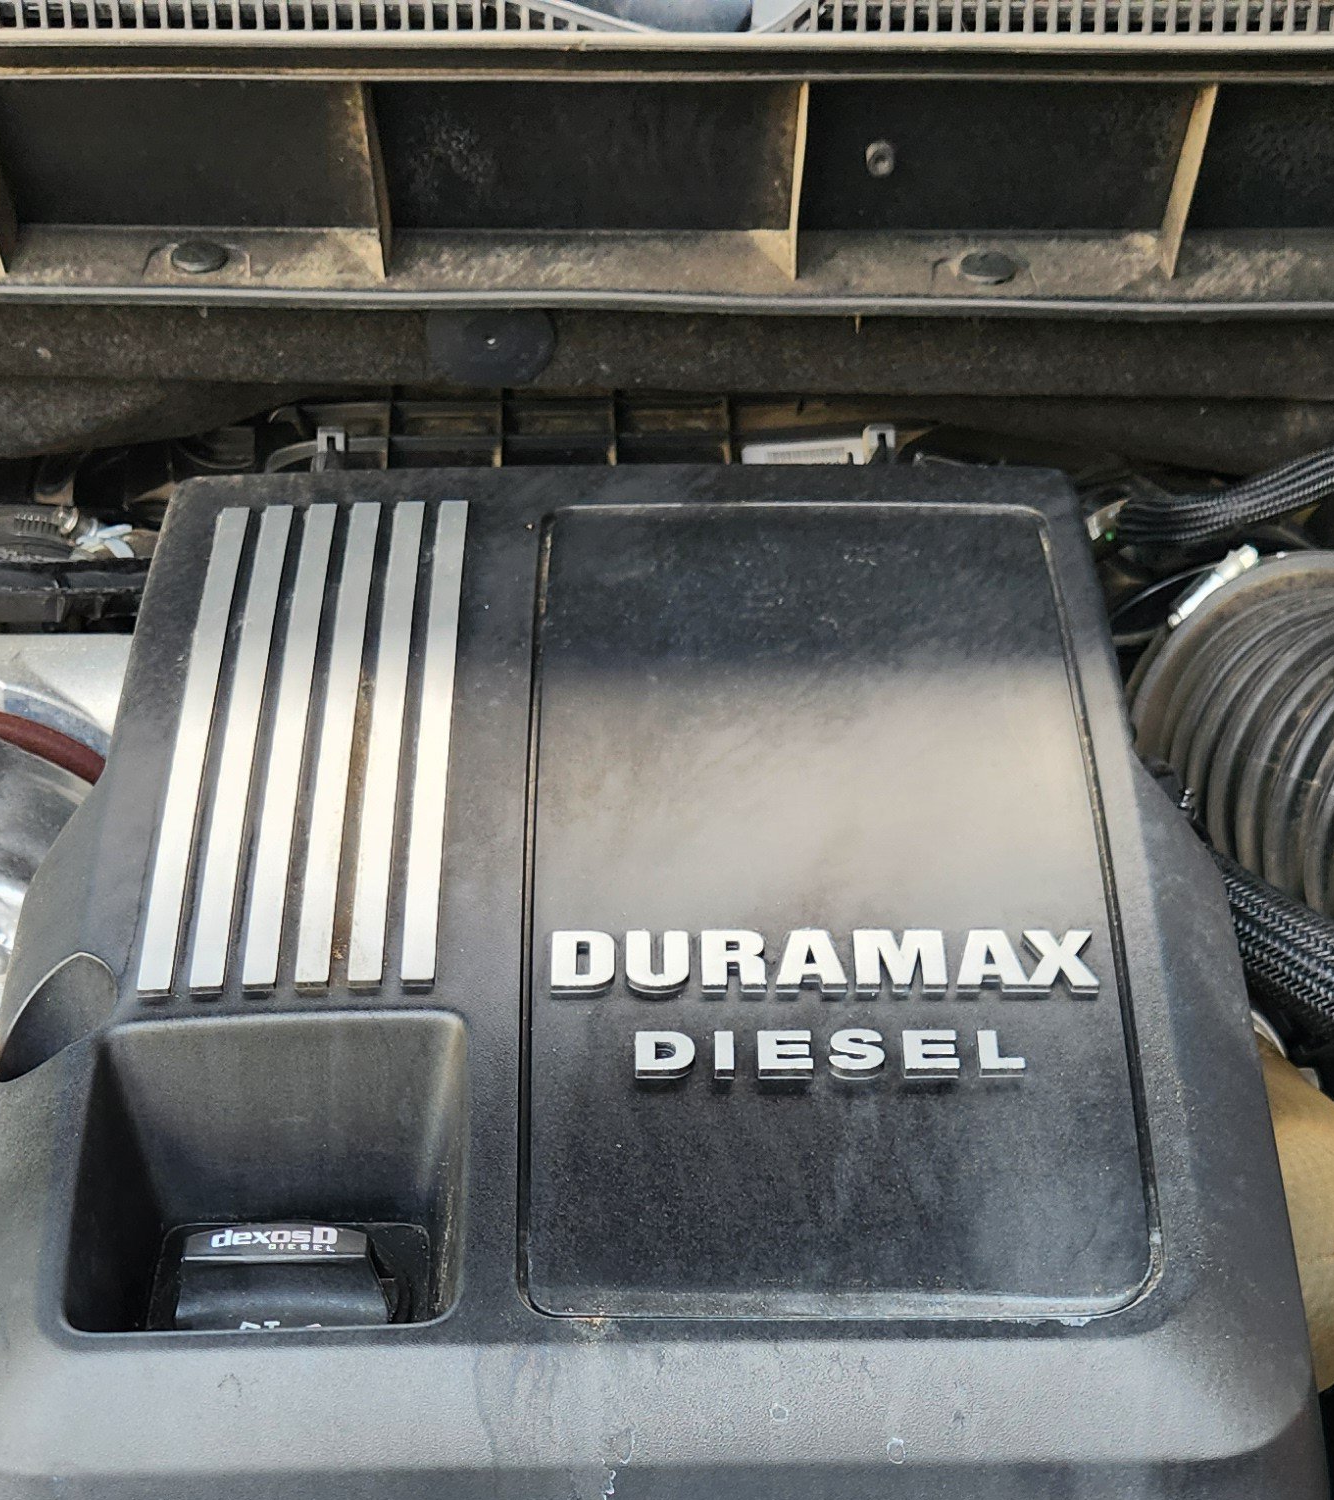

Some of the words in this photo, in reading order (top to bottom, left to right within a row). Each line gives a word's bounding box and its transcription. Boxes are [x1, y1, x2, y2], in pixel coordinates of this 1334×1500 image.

[550, 929, 1101, 1000] DURAMAX
[634, 1028, 1027, 1080] DIESEL
[267, 1242, 336, 1253] DIESEL
